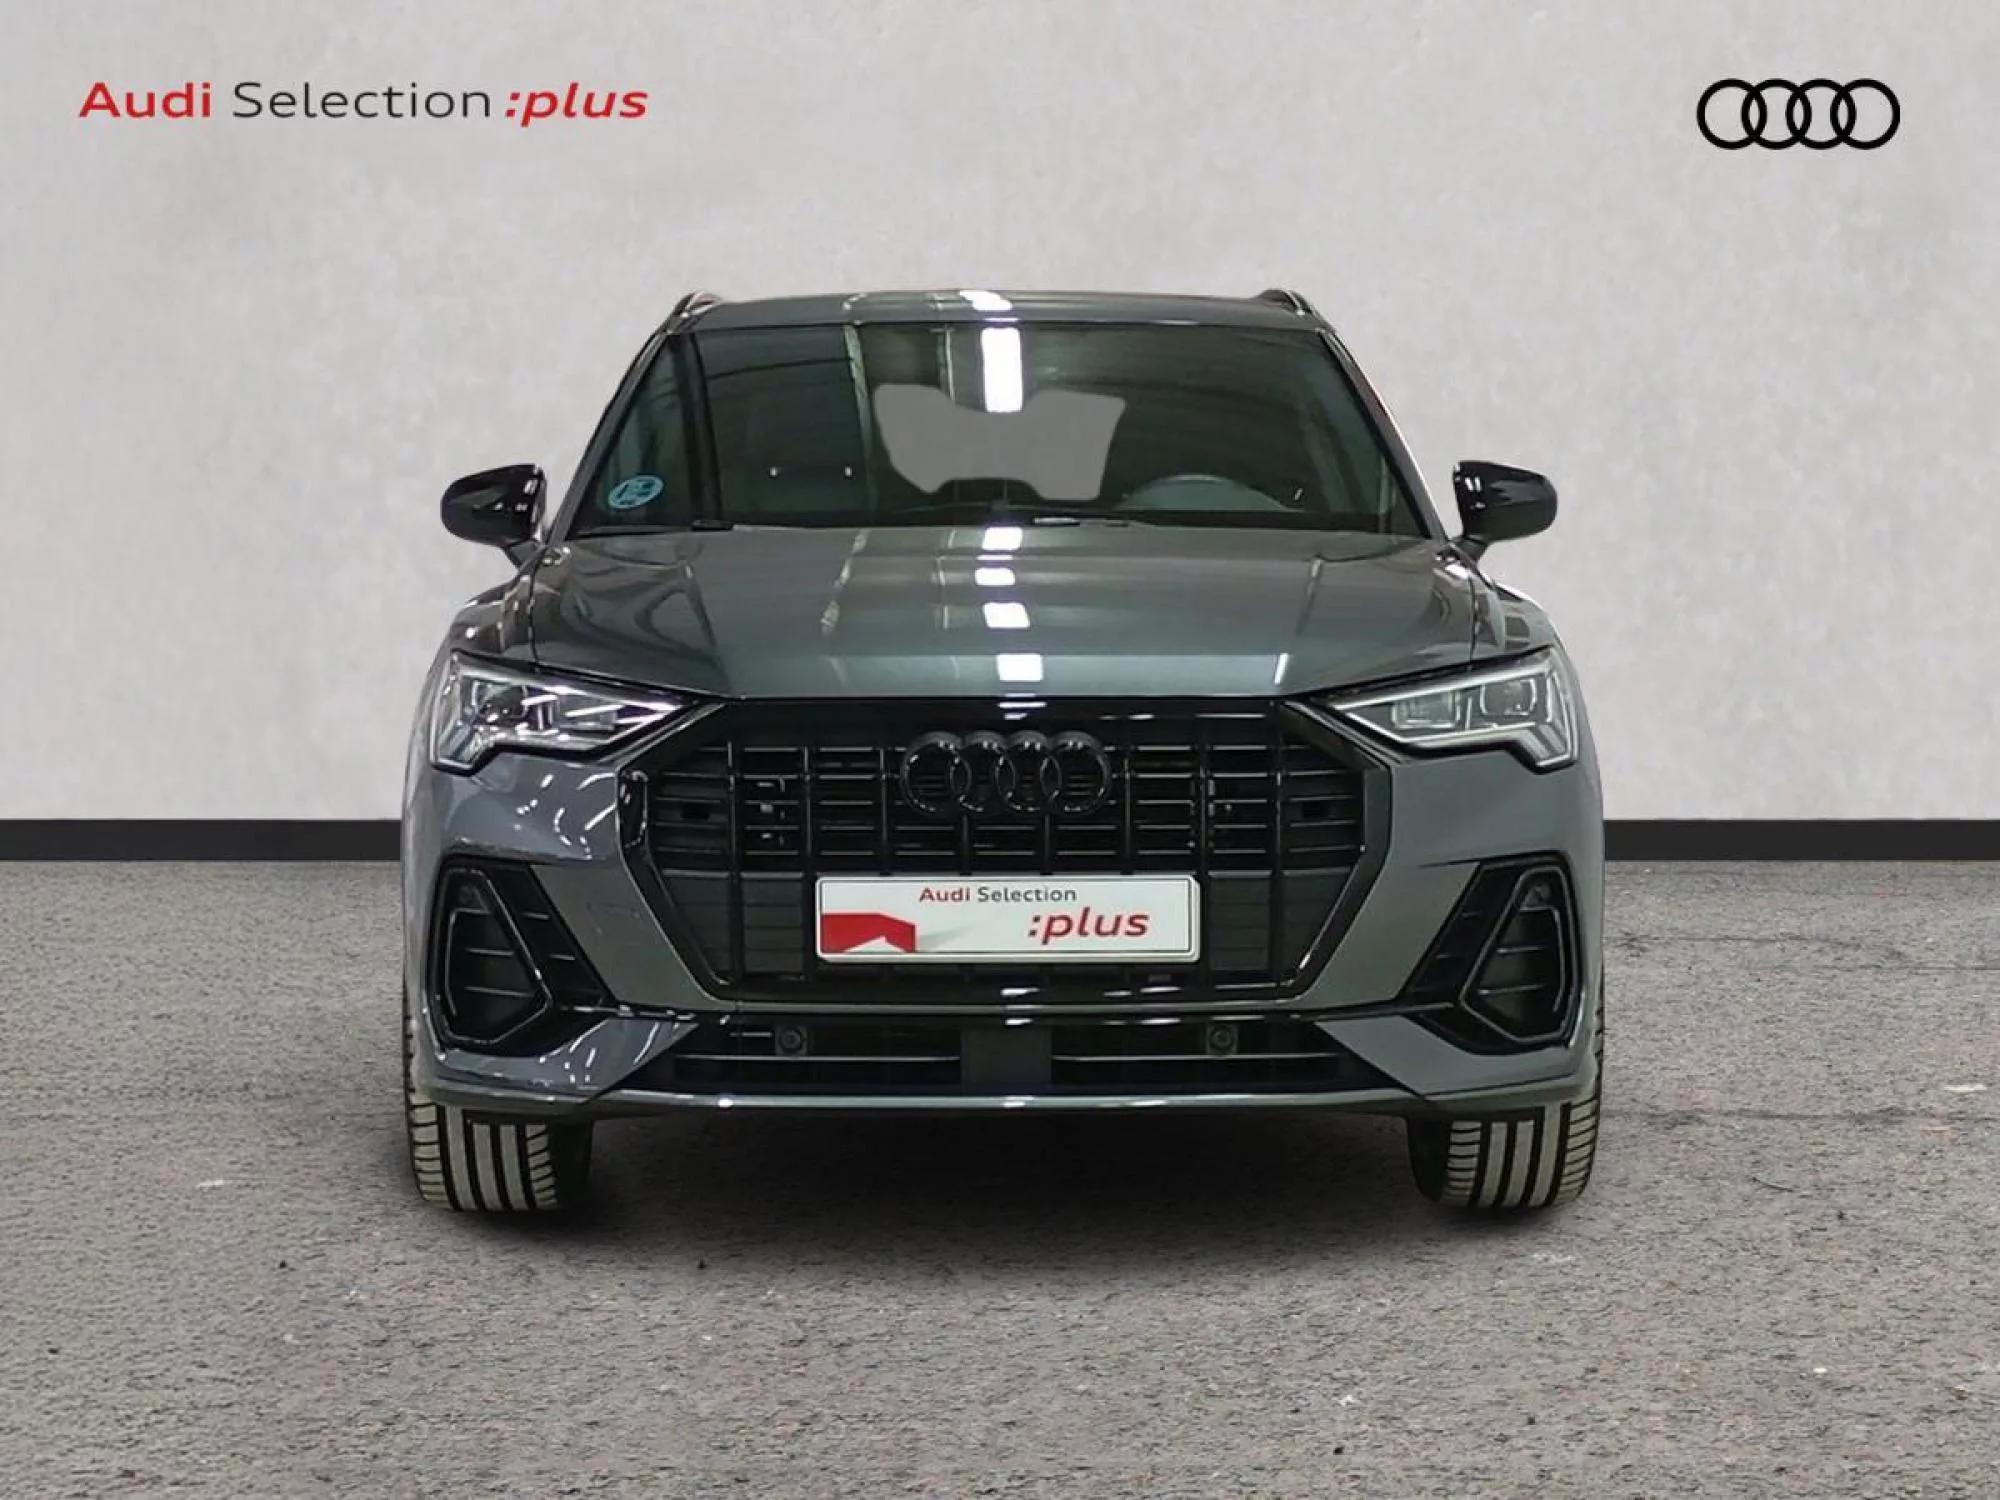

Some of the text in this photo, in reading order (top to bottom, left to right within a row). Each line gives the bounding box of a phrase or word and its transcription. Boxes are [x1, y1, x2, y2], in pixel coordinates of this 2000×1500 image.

[918, 886, 1078, 903] Audi Selection
[1027, 906, 1151, 946] :plus
